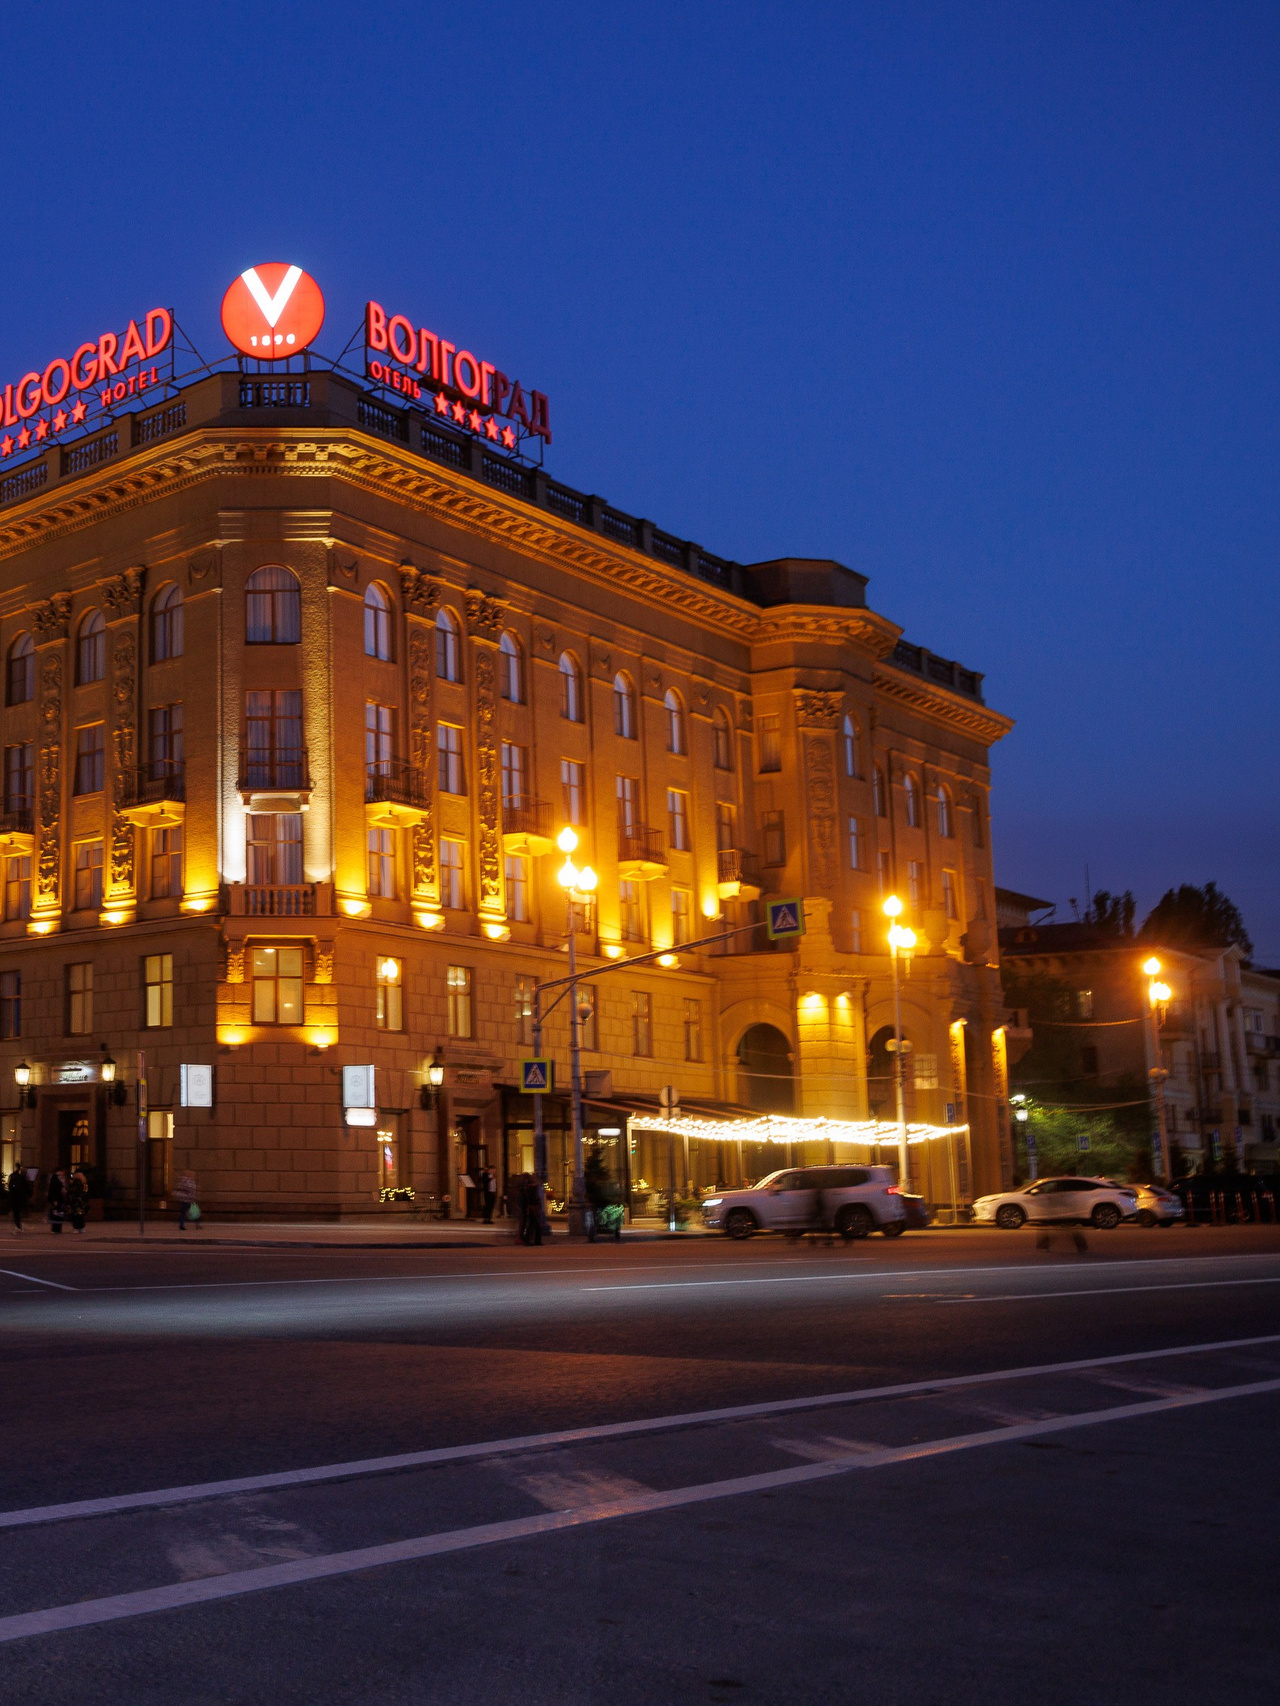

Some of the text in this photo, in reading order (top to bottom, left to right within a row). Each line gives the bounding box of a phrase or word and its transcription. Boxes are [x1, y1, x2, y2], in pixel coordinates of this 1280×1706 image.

[241, 264, 303, 328] V
[250, 333, 296, 347] 1890
[101, 366, 159, 407] HOTEL
[366, 300, 552, 445] ВОЛГОГРАД
[369, 361, 422, 399] ОТЕЛЬ
